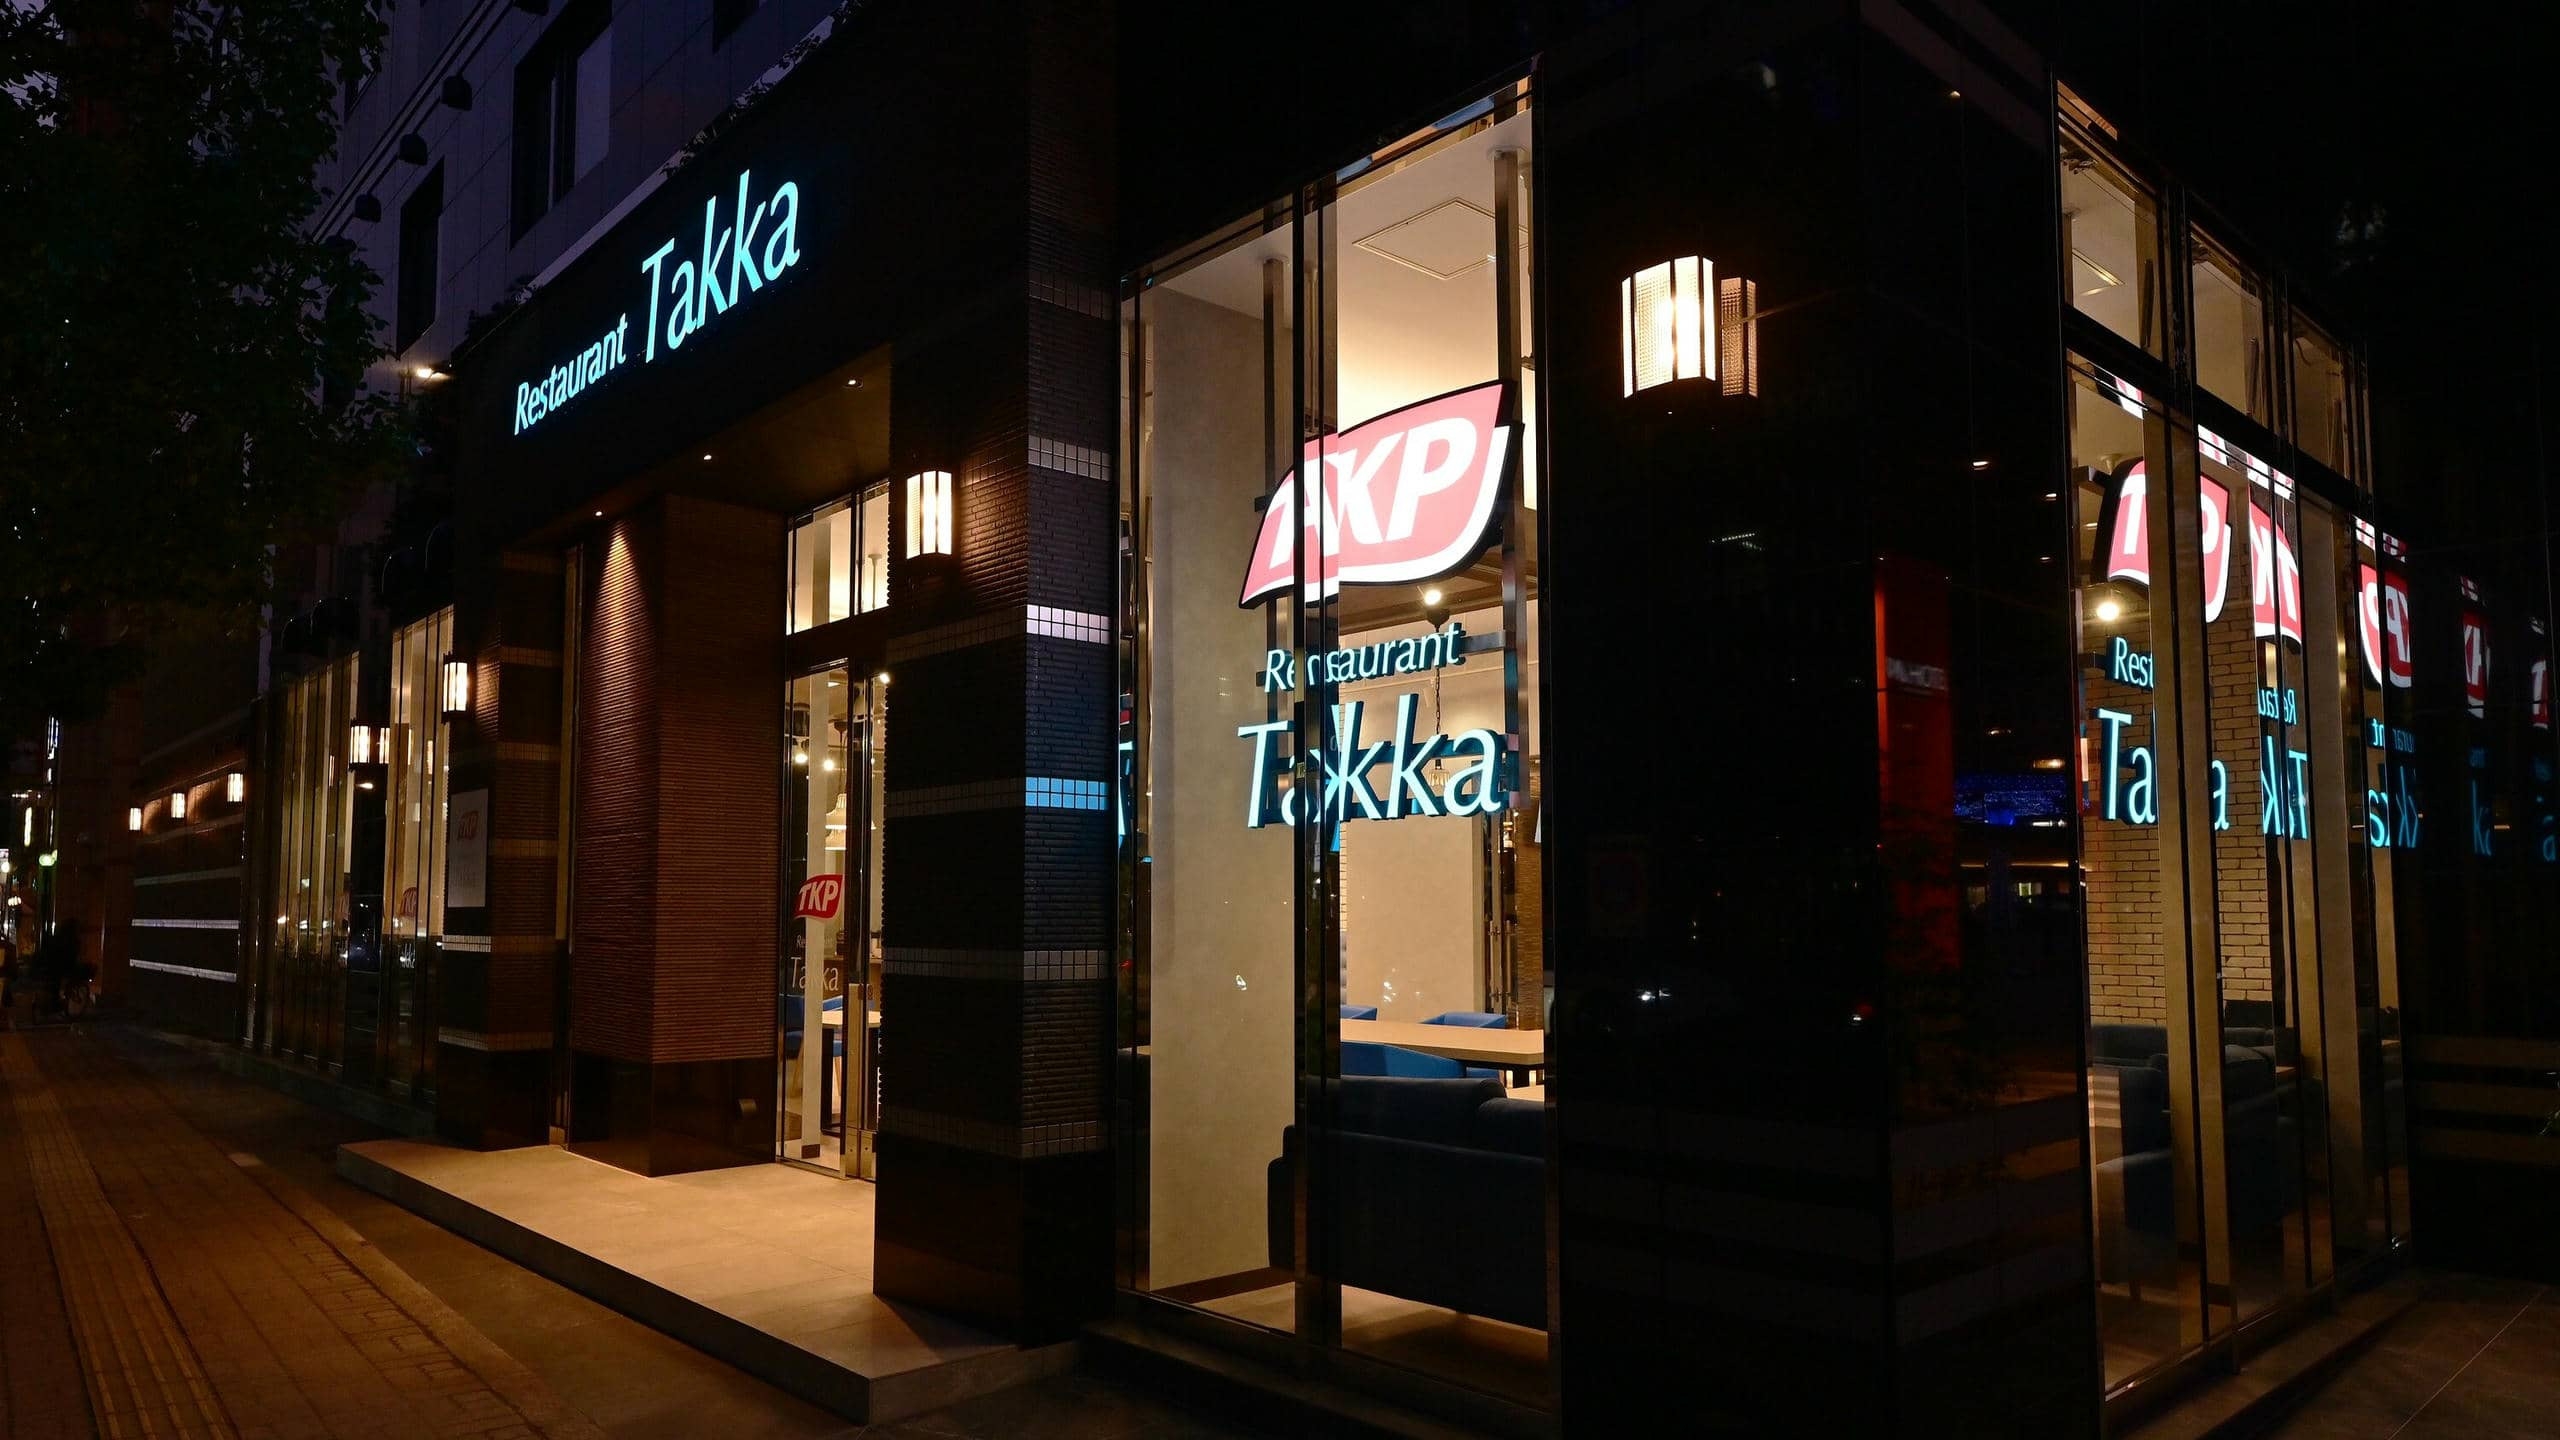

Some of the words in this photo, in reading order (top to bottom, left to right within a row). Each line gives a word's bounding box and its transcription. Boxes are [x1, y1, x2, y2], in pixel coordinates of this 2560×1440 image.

[513, 312, 628, 436] Restaurant
[641, 168, 801, 364] Takka
[798, 879, 839, 912] TKP
